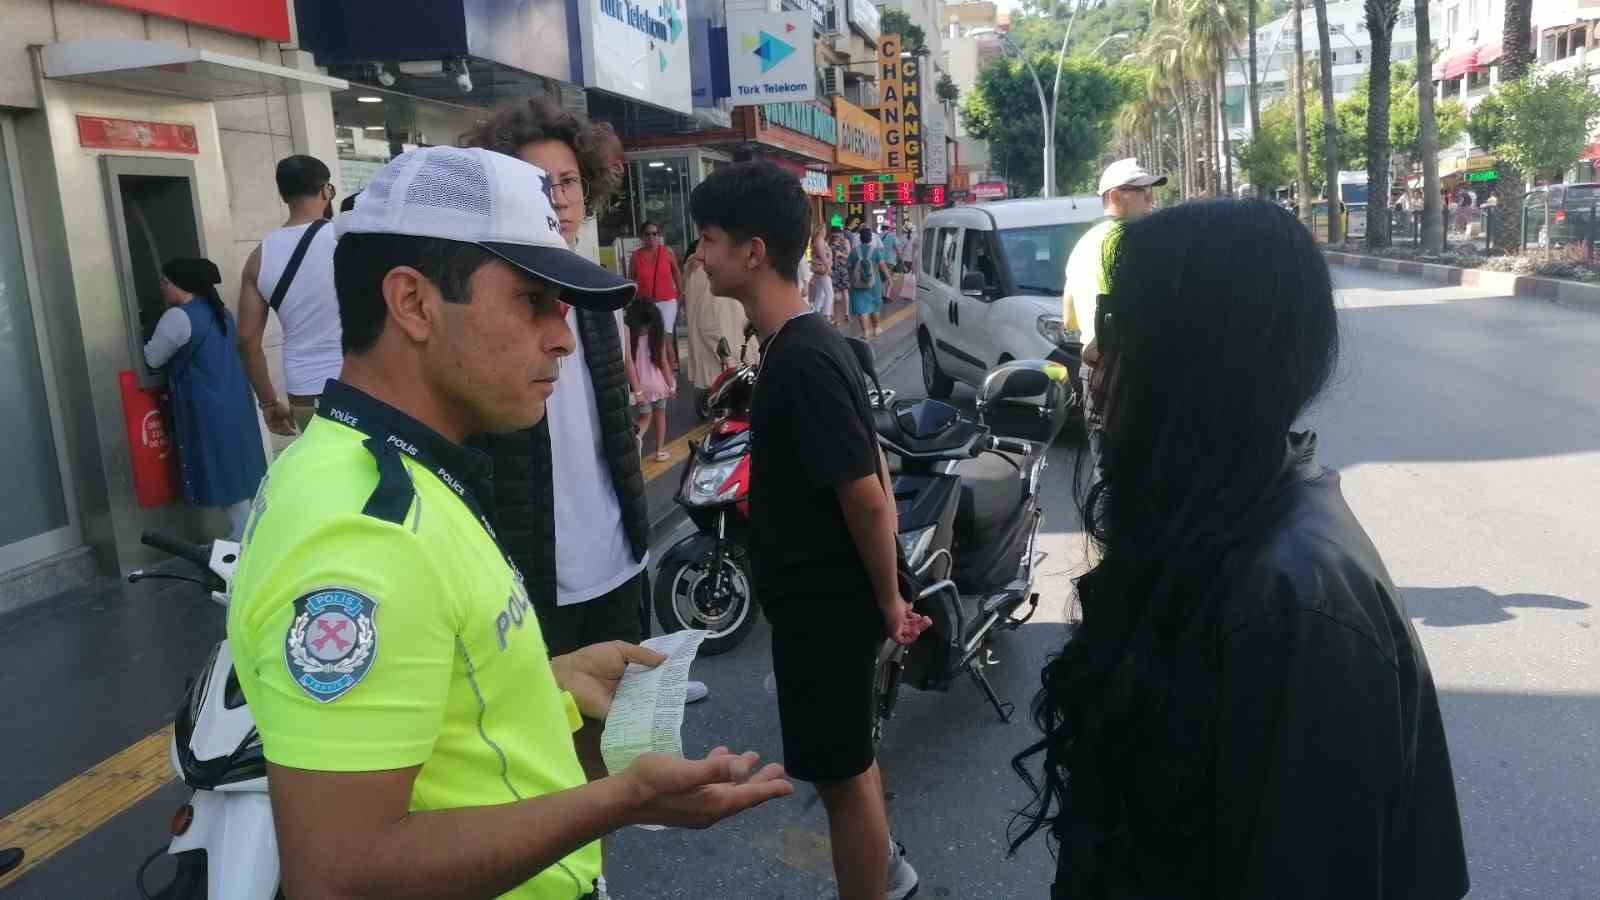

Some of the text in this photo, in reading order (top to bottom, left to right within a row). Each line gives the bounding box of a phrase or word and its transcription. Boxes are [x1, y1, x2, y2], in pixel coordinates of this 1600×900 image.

[737, 81, 808, 96] Türk Telekom
[882, 41, 899, 168] CHANGE
[902, 61, 920, 175] CHANGE
[545, 215, 560, 232] PO
[386, 434, 418, 456] POLİS
